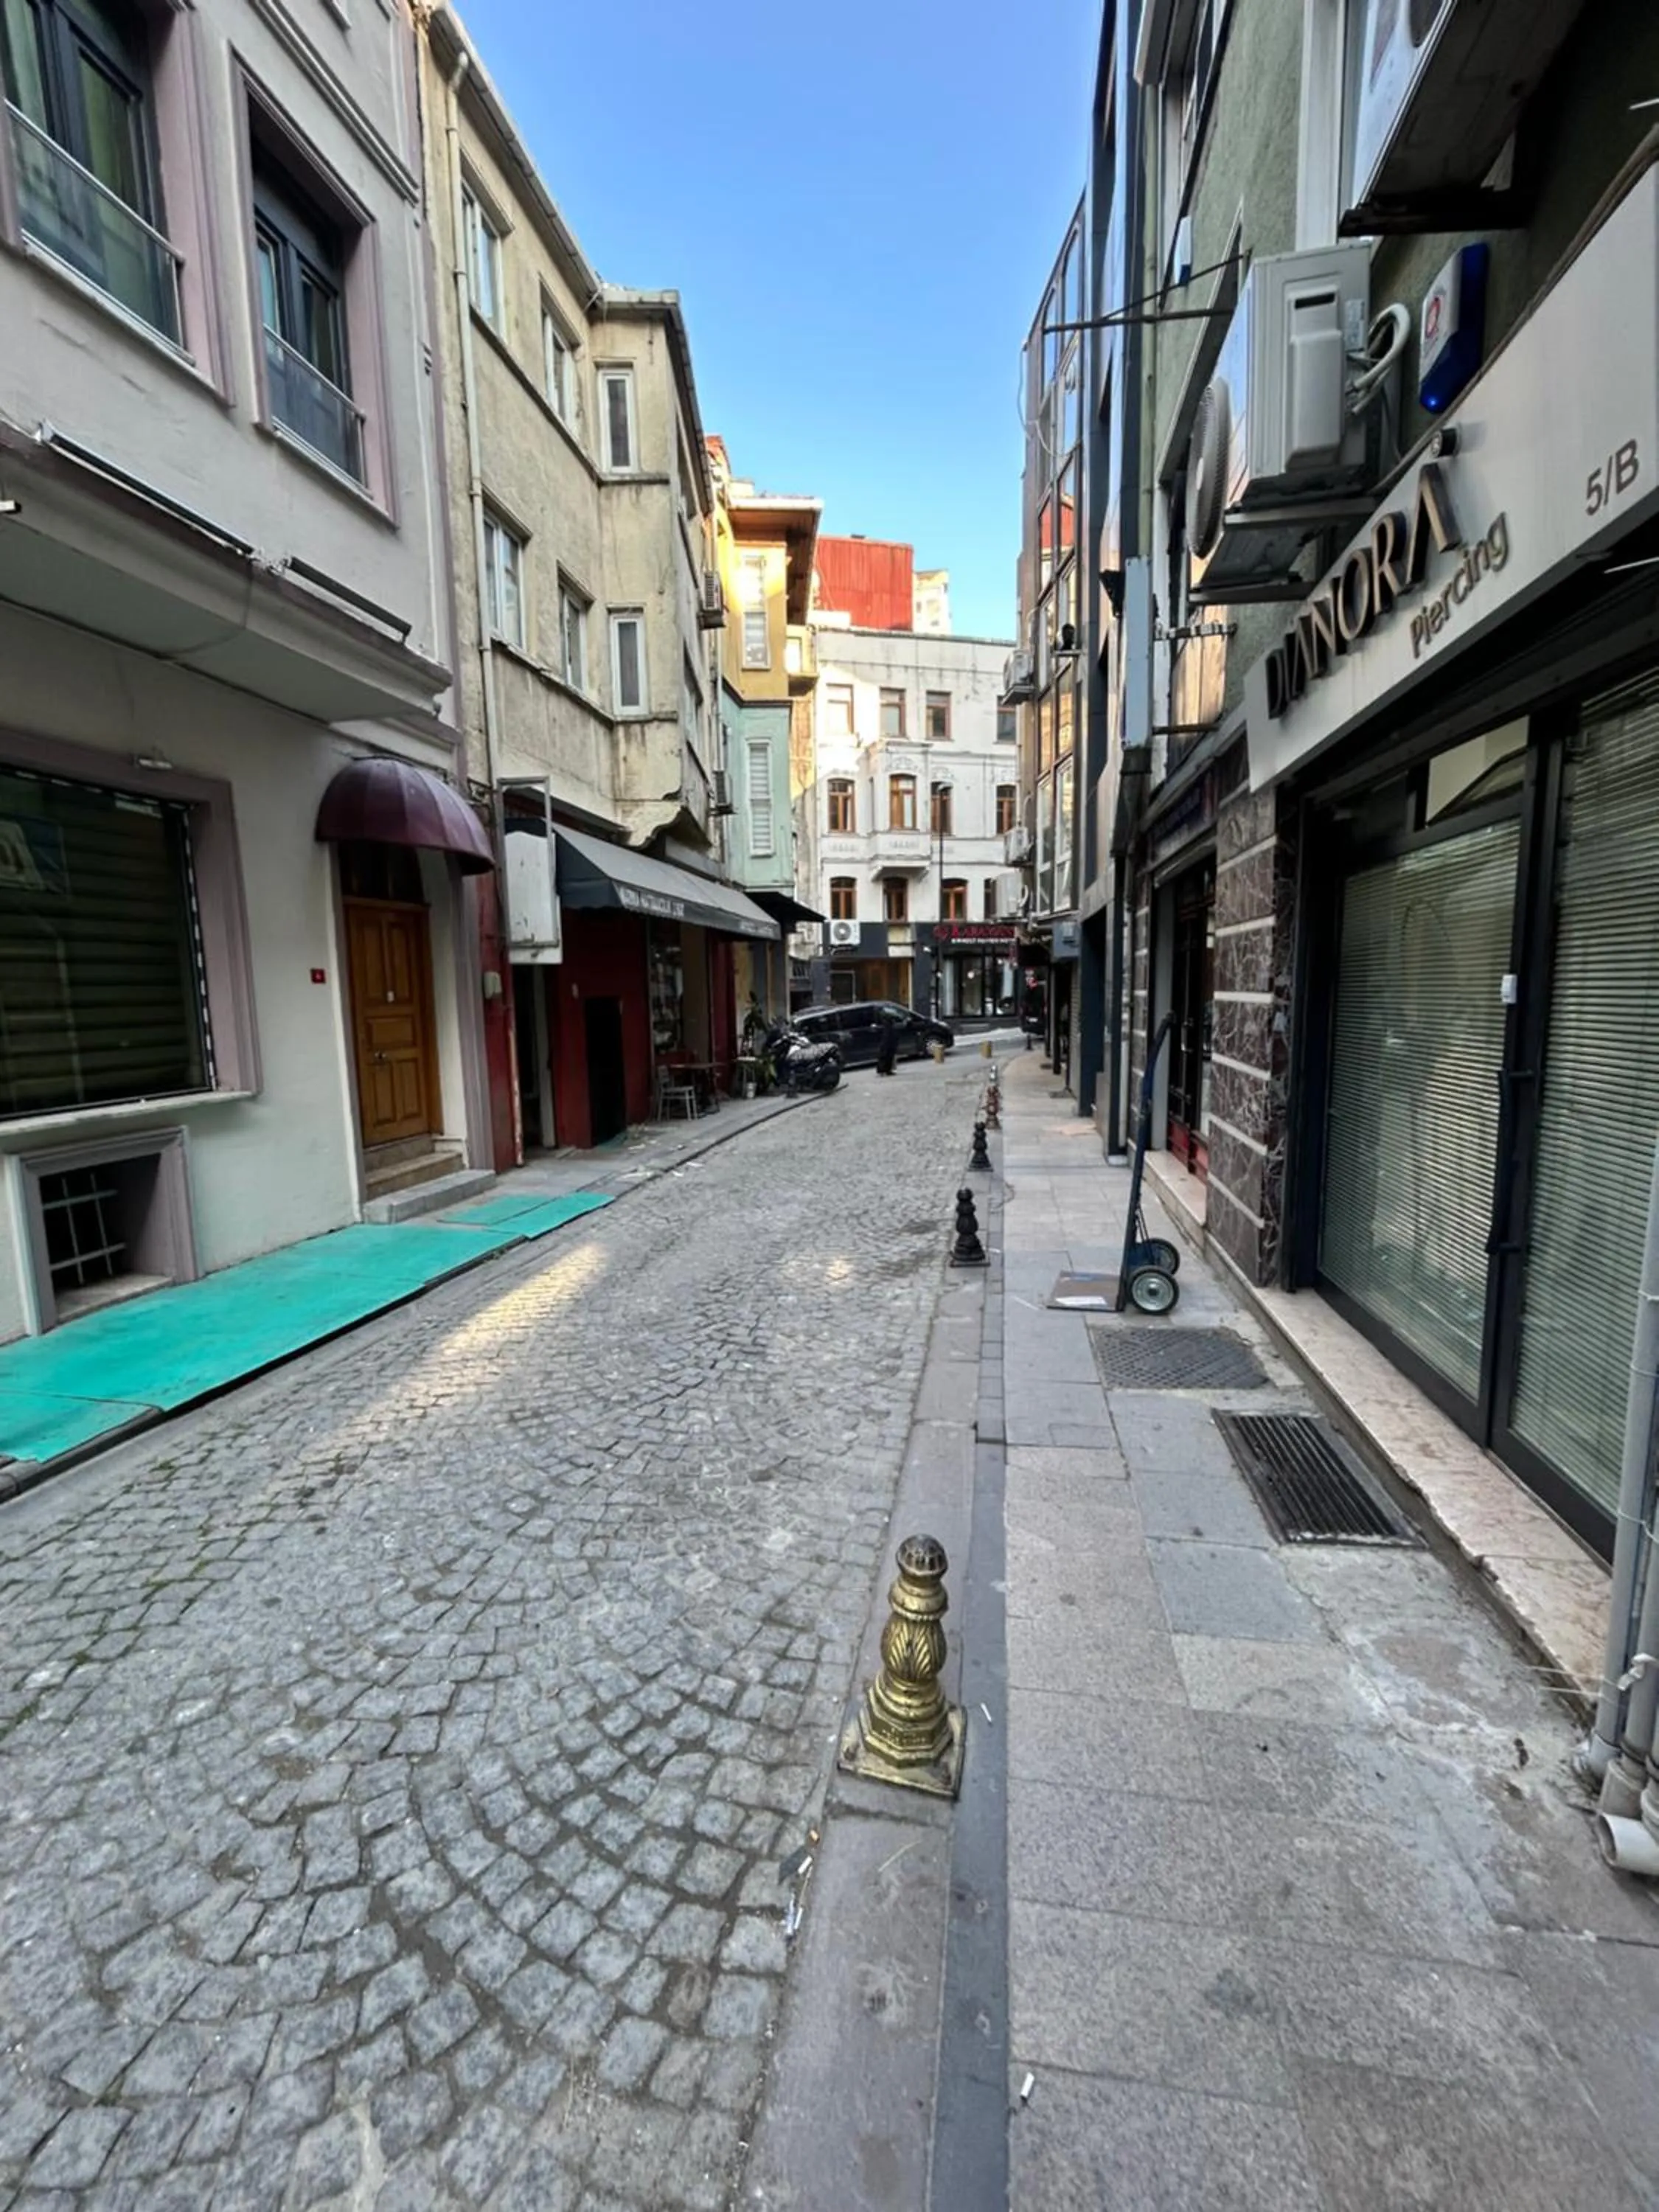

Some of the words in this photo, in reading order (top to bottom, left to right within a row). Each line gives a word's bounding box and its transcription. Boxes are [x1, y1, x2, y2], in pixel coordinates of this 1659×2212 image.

[1585, 439, 1639, 516] 5/B
[1265, 462, 1461, 720] DIANORA
[1410, 512, 1509, 659] Piercing
